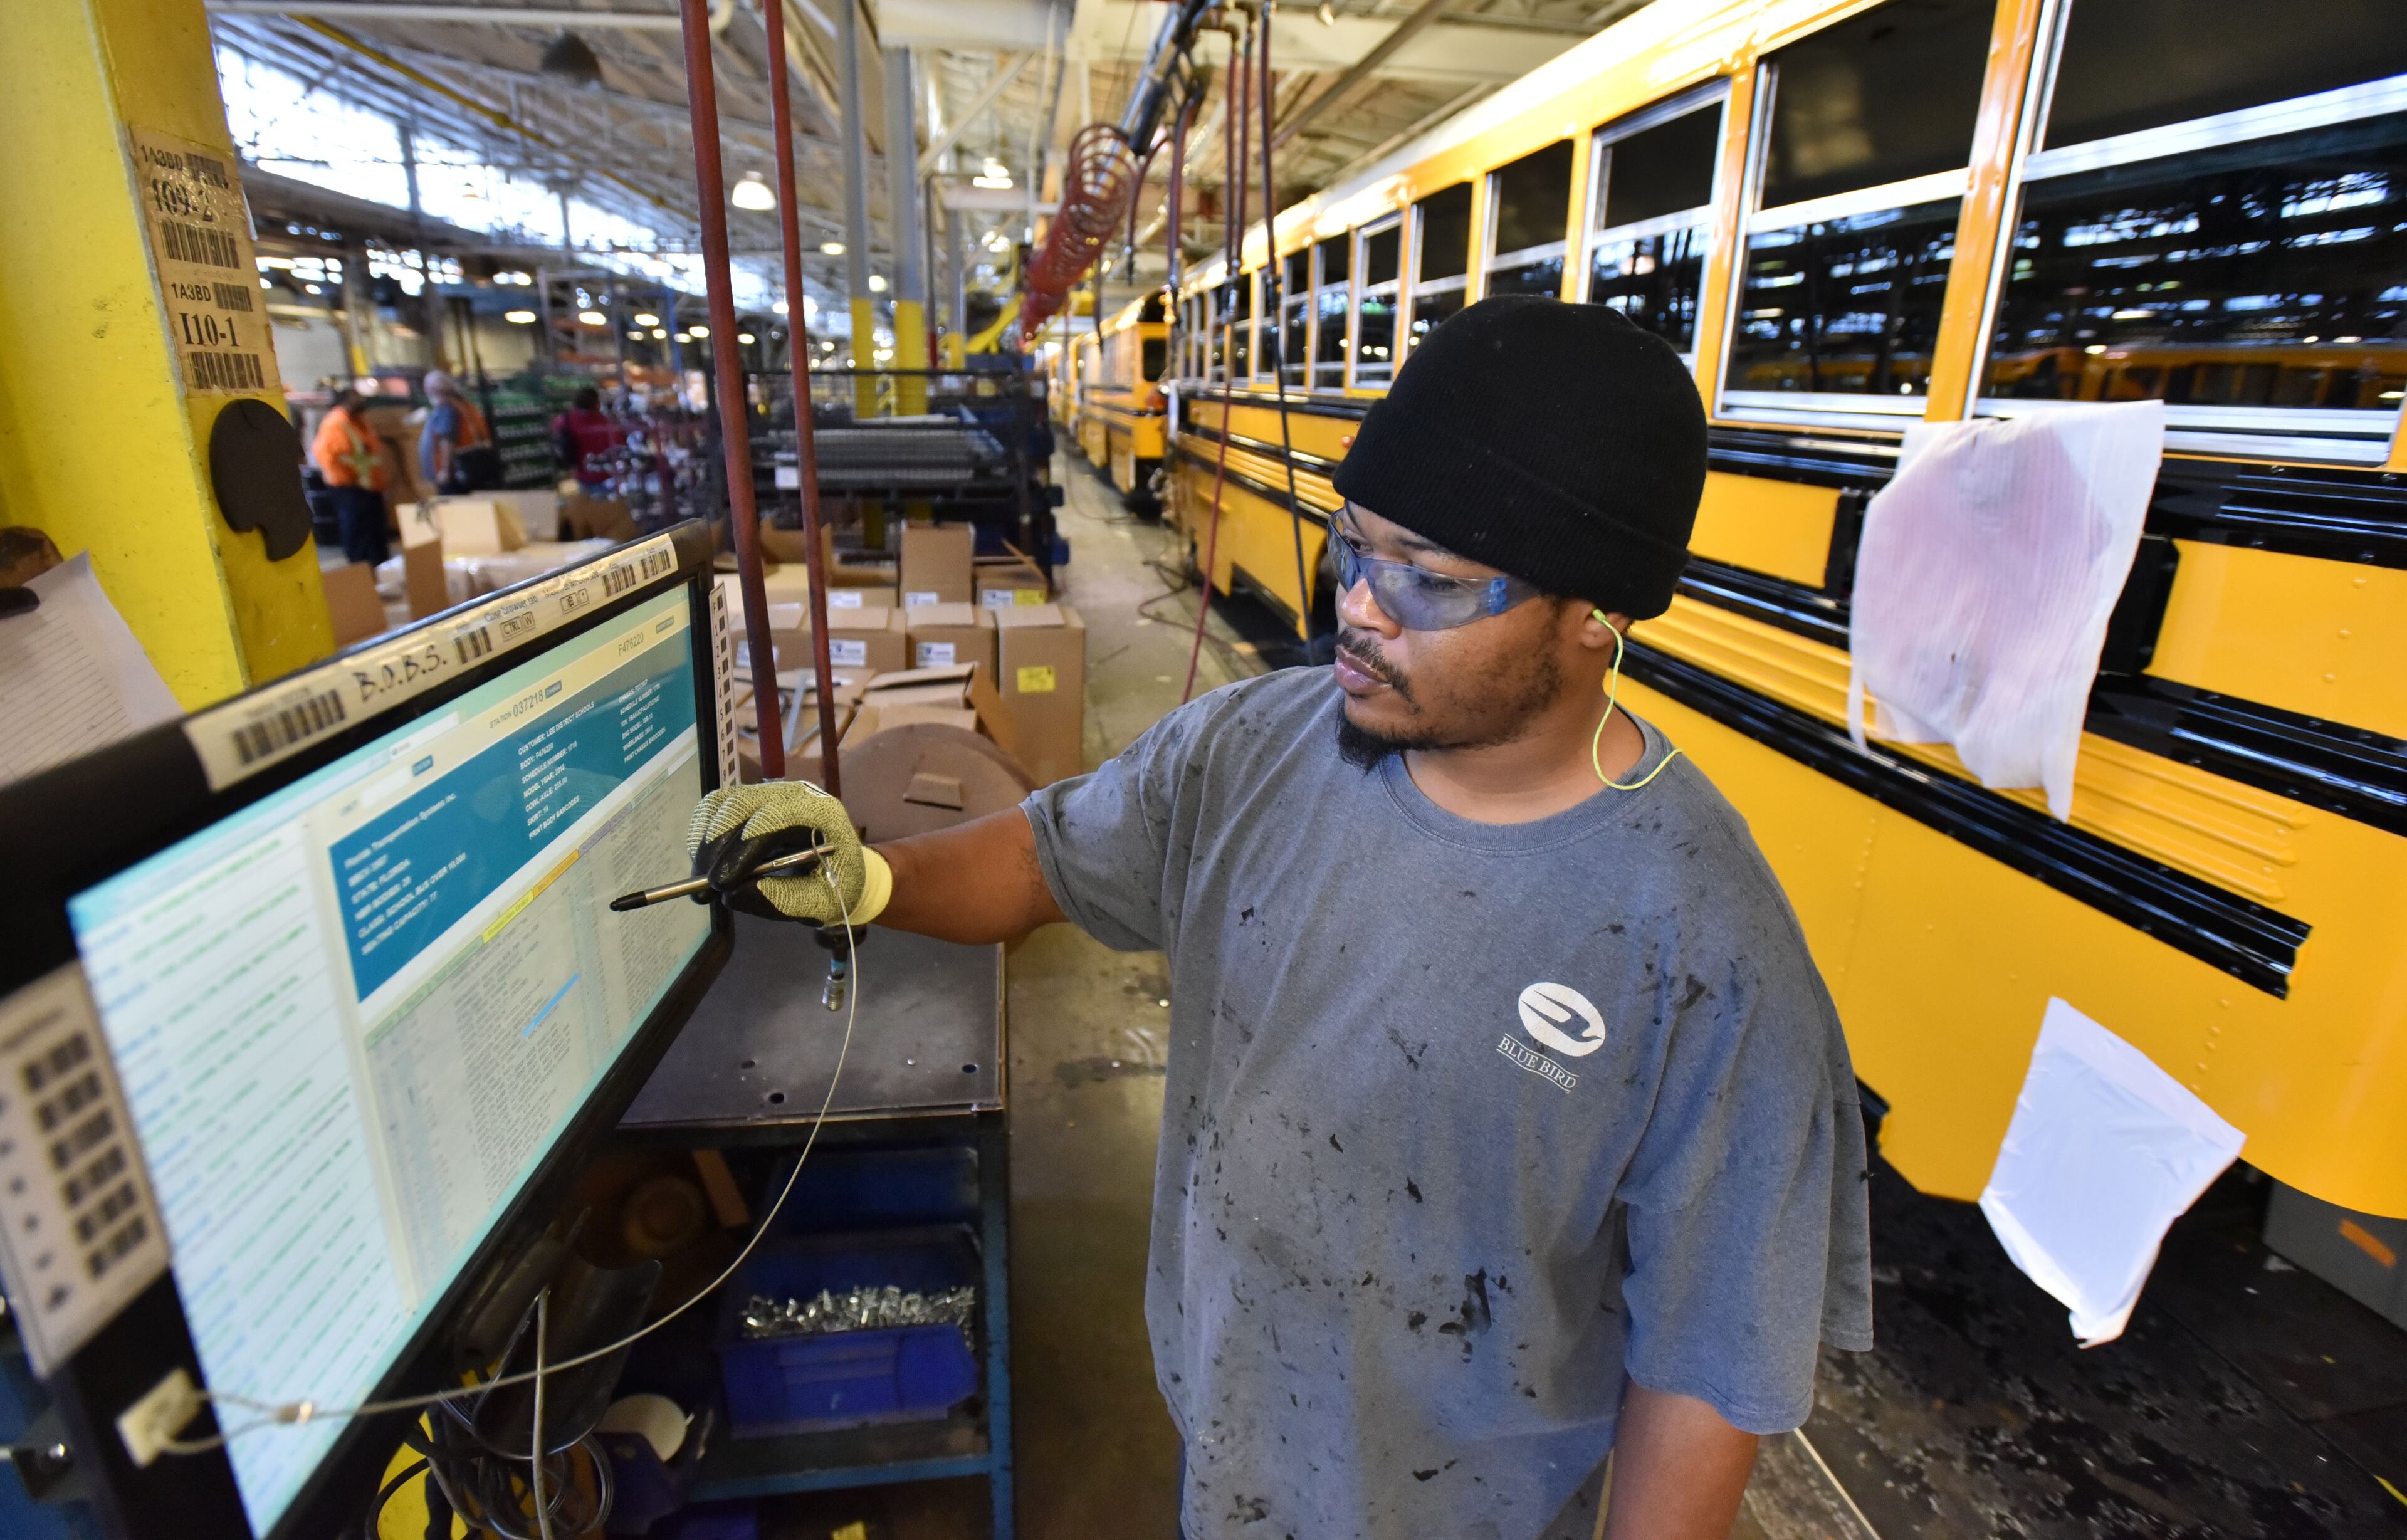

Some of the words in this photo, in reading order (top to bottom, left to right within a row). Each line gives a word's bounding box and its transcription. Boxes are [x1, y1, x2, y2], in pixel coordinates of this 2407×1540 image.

[171, 282, 211, 301] 1A3BD
[484, 608, 501, 622] Close
[503, 600, 527, 615] browser
[528, 594, 538, 606] tab
[503, 620, 521, 636] CTRL
[525, 616, 533, 627] W
[618, 632, 644, 656] F476220
[716, 646, 720, 659] 2
[717, 666, 721, 680] 3
[718, 687, 722, 699] 4
[490, 710, 513, 728] STATION
[513, 690, 544, 718] 037218
[619, 698, 638, 715] SCHEDULE
[720, 708, 723, 721] 5
[518, 733, 547, 755] CUSTOMER:
[546, 726, 555, 737] LEE
[555, 713, 575, 731] DISTRICT
[575, 701, 595, 718] SCHOOLS
[721, 729, 725, 741] 6
[624, 751, 634, 764] PRINT
[634, 740, 649, 755] CHASSIS
[648, 726, 666, 744] BARCODES
[520, 755, 535, 770] BODY:
[721, 750, 725, 762] 7
[522, 762, 547, 784] SCHEDULE
[547, 748, 568, 767] NUMBER:
[723, 770, 726, 782] 8
[523, 782, 540, 799] MODEL
[540, 772, 555, 785] YEAR:
[527, 810, 543, 826] SKIRT:
[528, 824, 543, 840] PRINT
[543, 814, 557, 829] BODY
[556, 795, 580, 818] BARCODES
[385, 891, 415, 918] SCHOOL
[415, 879, 430, 896] BUS
[429, 865, 448, 884] OVER
[1497, 1035, 1539, 1068] BLUE
[1538, 1060, 1576, 1089] BIRD
